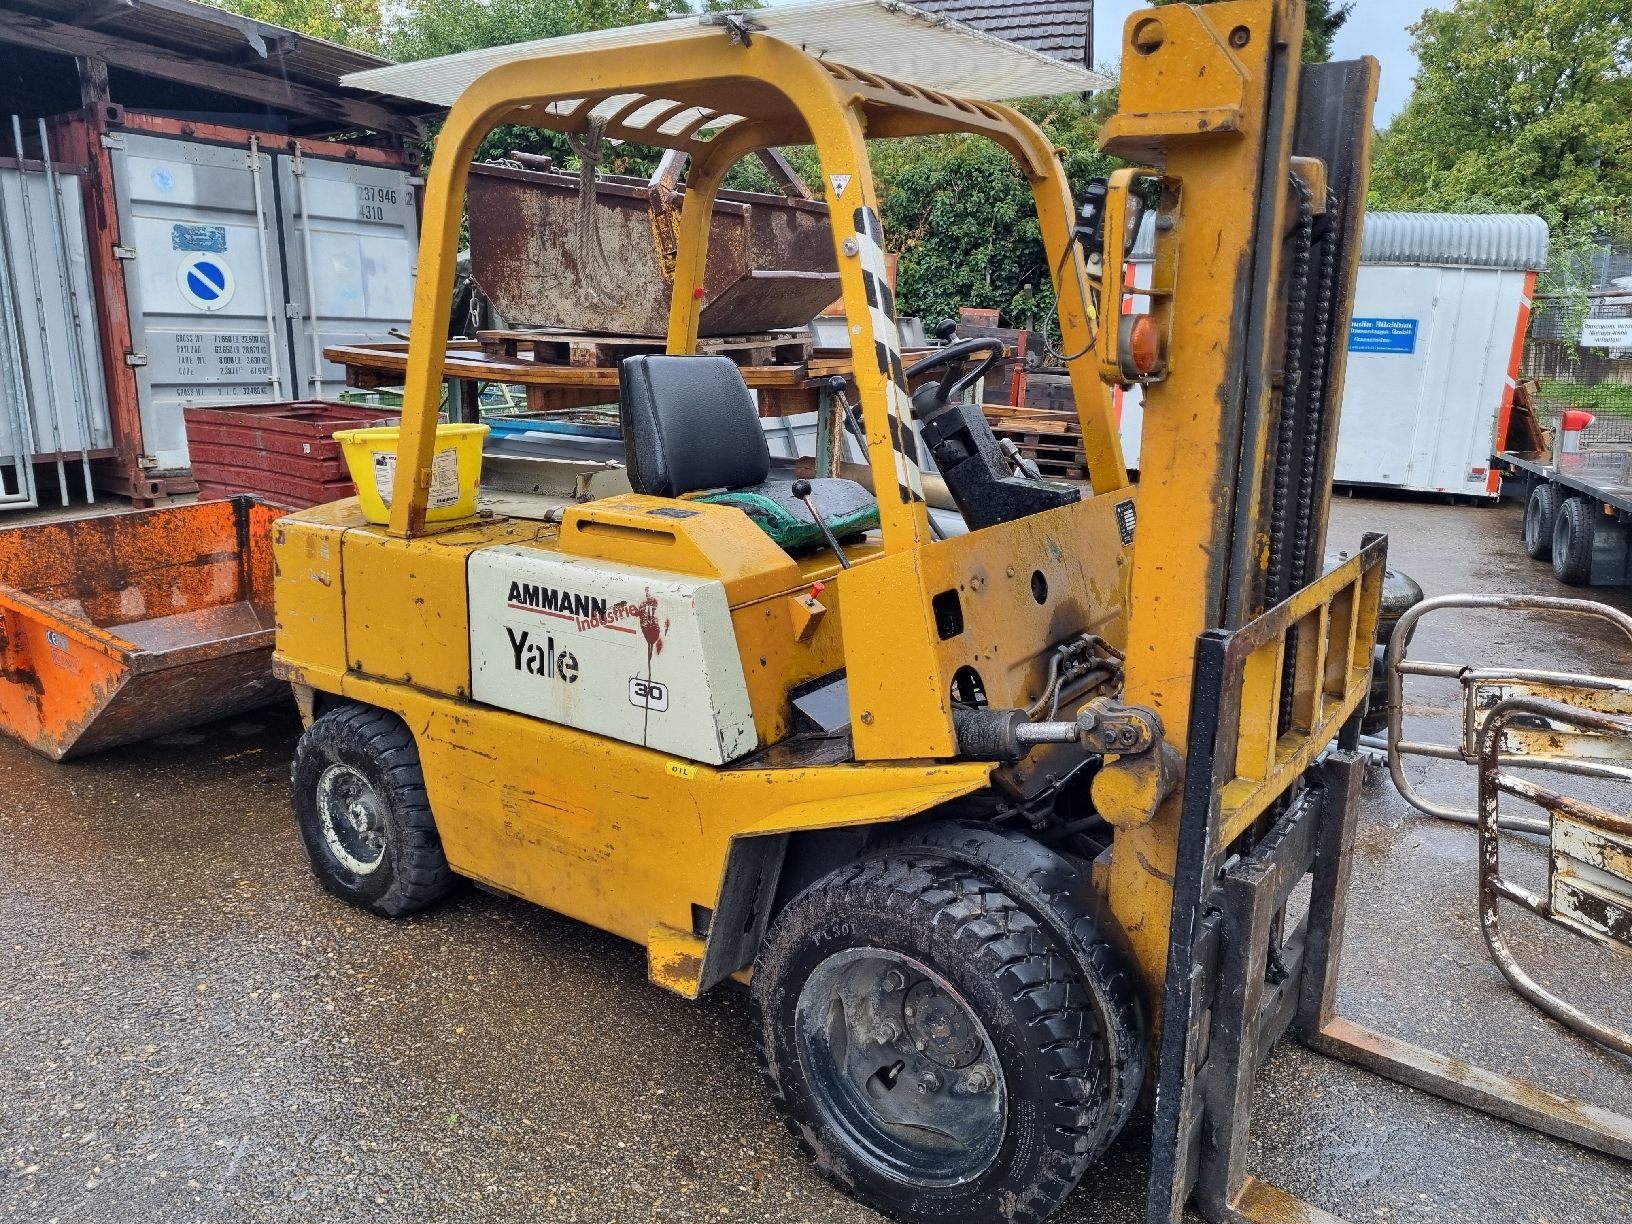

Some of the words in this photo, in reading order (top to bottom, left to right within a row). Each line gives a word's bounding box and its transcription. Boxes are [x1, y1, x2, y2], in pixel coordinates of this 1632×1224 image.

[378, 189, 397, 205] 946
[176, 334, 193, 343] GROSS
[176, 345, 202, 354] PAYLOAD
[178, 356, 193, 365] TARE
[508, 581, 607, 618] AMMANN
[503, 625, 579, 683] Yale
[634, 682, 663, 700] 30
[671, 766, 689, 776] OIL
